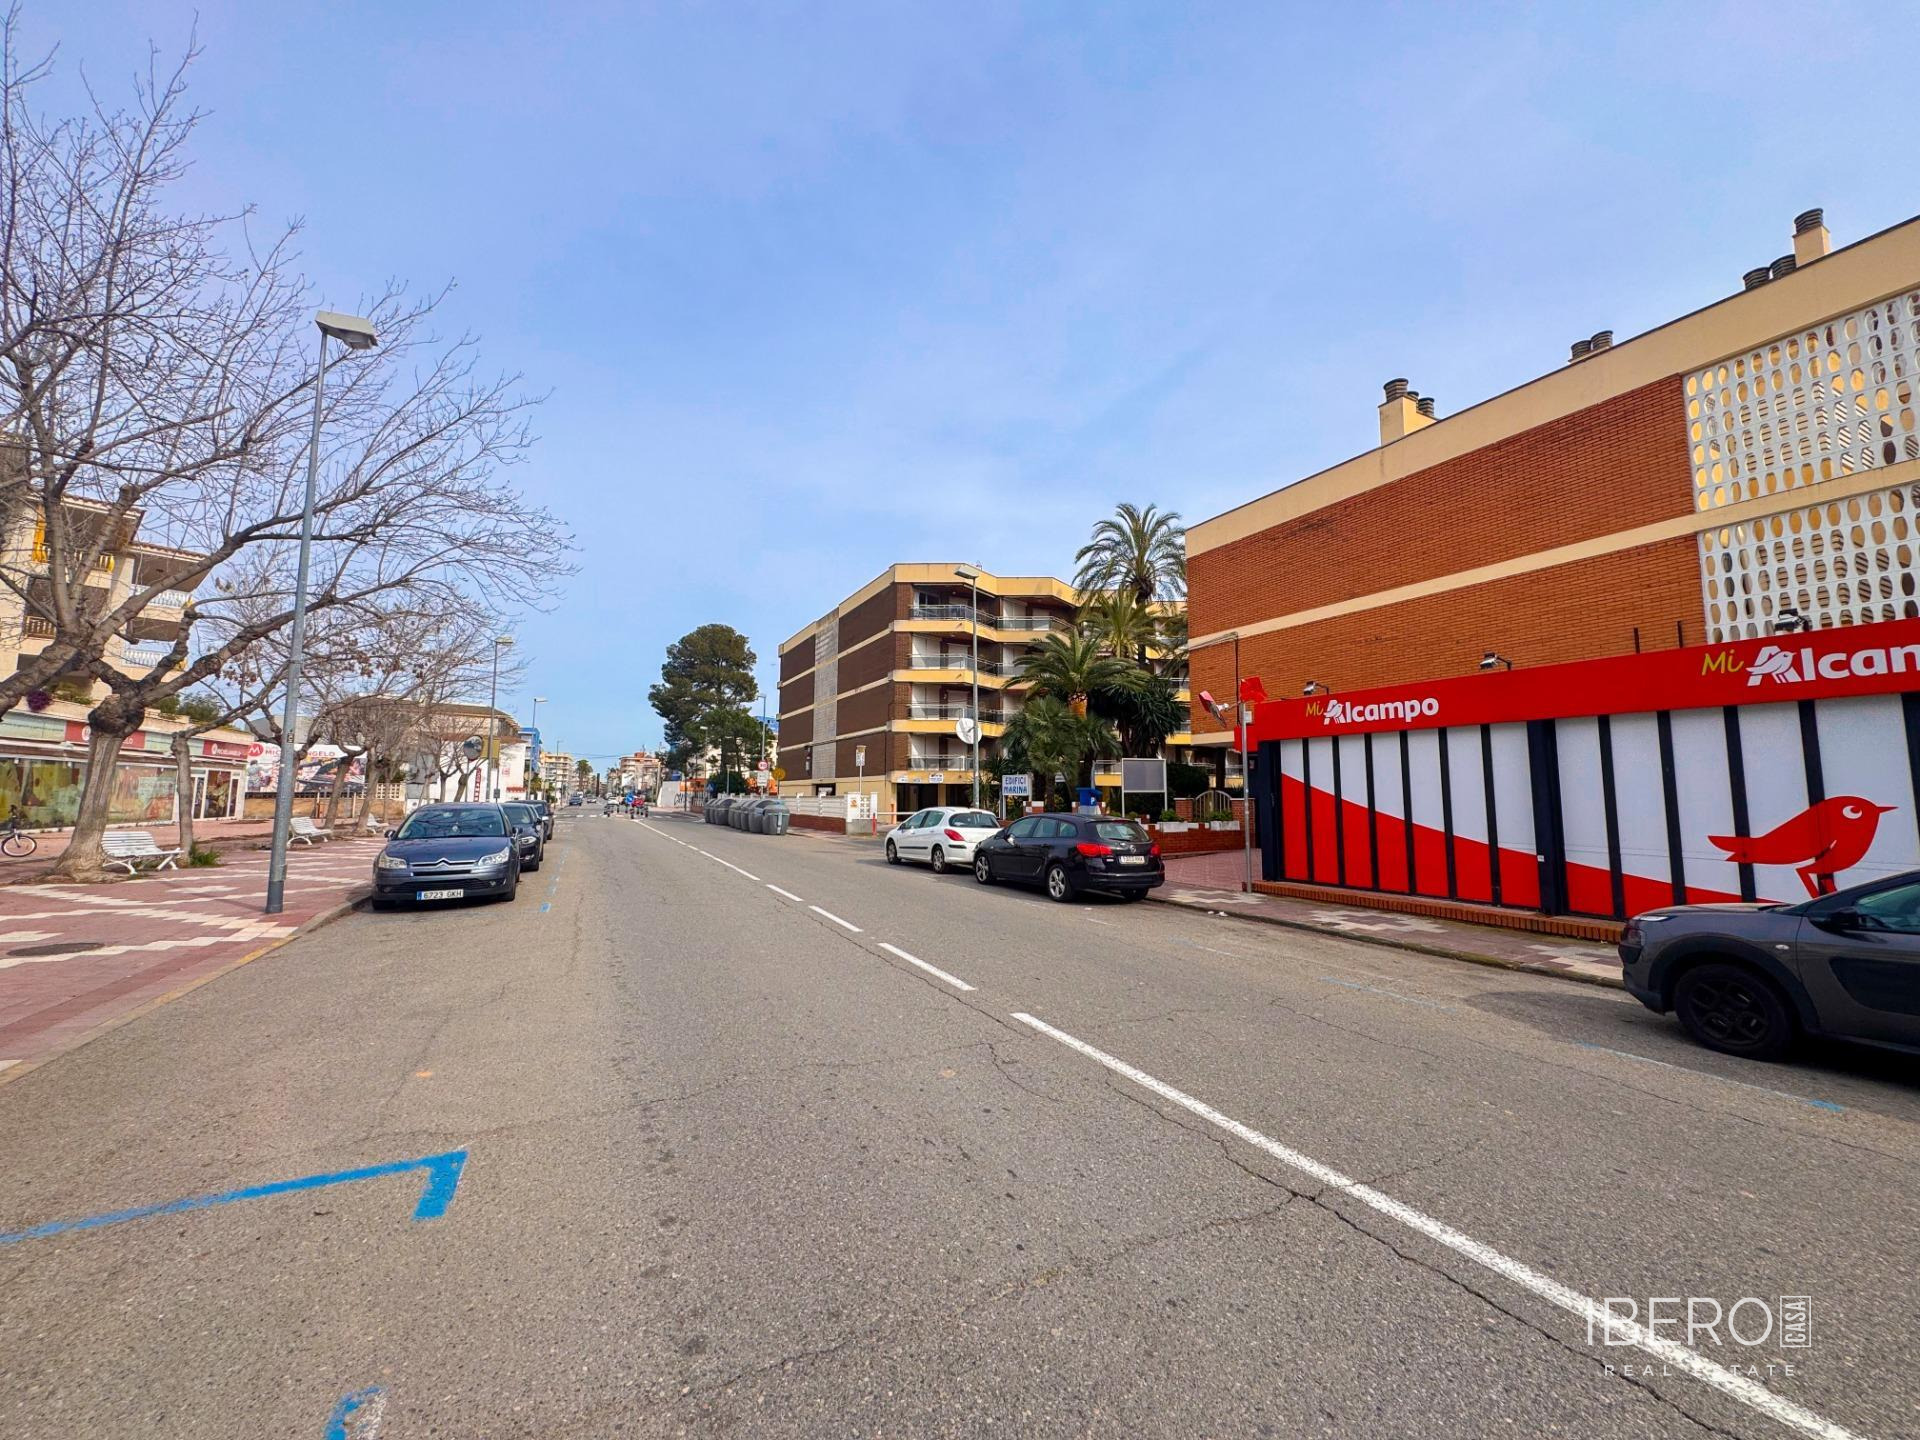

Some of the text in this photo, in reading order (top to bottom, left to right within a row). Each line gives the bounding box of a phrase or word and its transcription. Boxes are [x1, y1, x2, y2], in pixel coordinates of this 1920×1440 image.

[1702, 649, 1744, 676] Mi
[1306, 698, 1439, 725] Mi Alcampo
[1005, 776, 1027, 785] EDIFICI
[1003, 786, 1028, 794] MARINA
